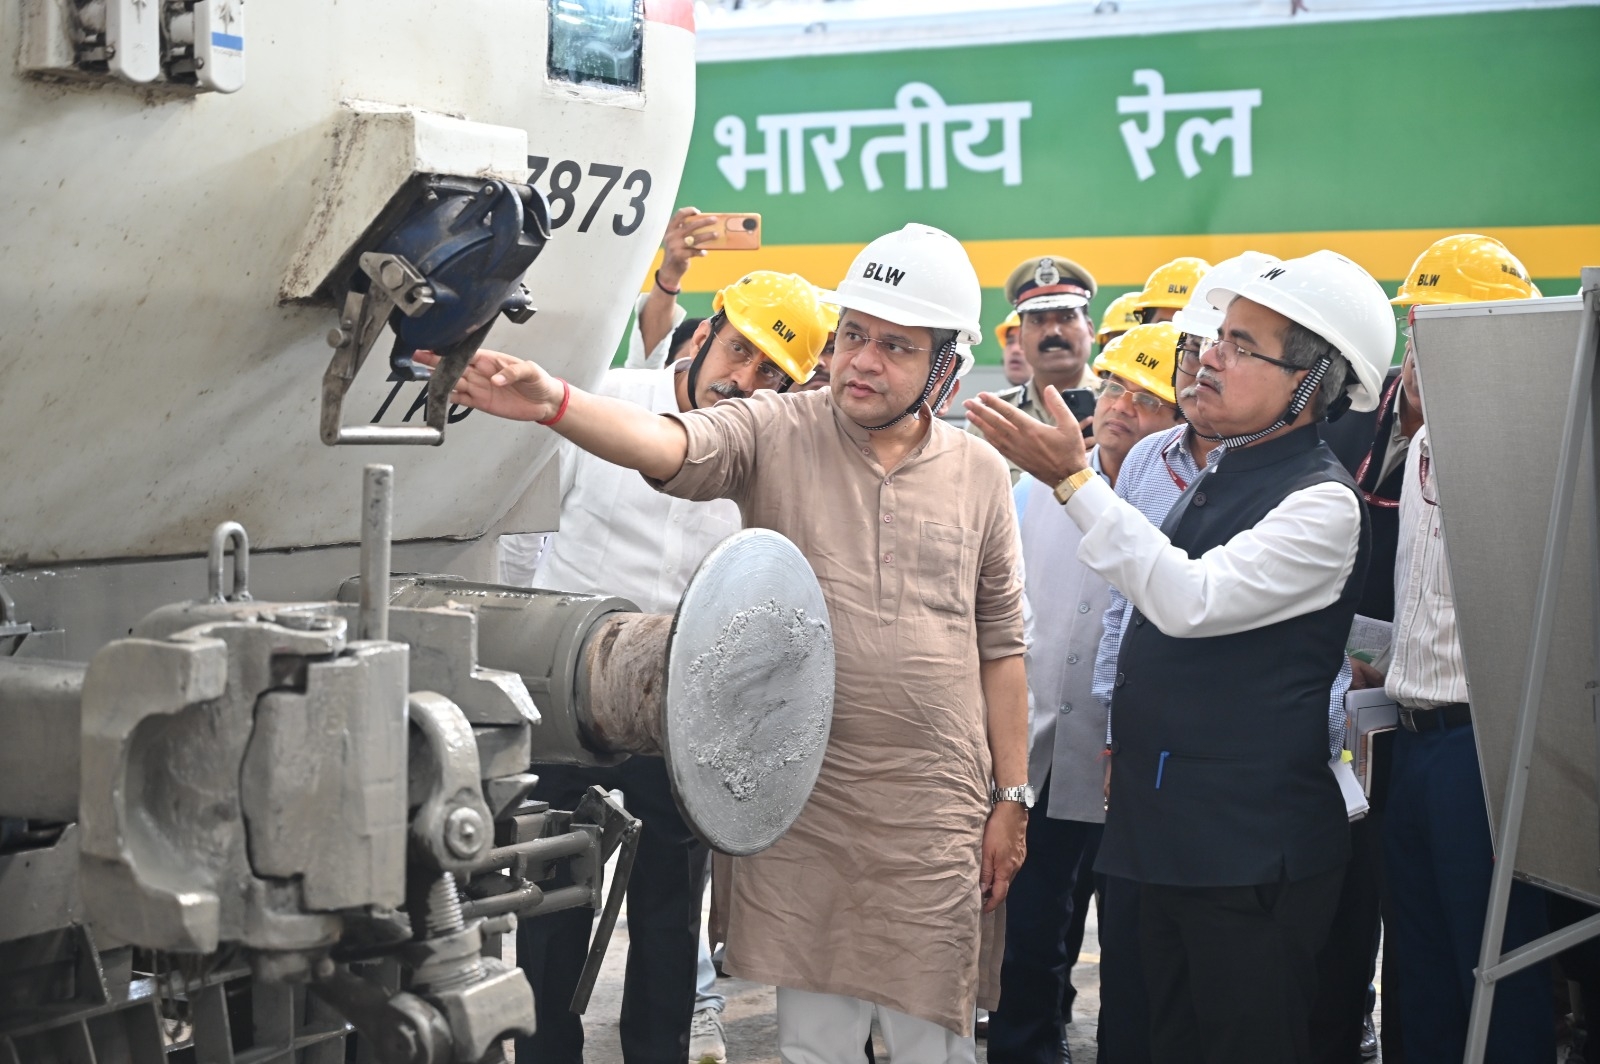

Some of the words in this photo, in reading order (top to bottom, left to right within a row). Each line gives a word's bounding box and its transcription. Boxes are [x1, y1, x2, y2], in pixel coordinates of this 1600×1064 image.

[713, 82, 1031, 194] भारतीय
[1116, 68, 1263, 182] रेल
[863, 262, 905, 286] BLW
[1417, 273, 1441, 287] BLW
[1168, 284, 1189, 294] BLW
[772, 320, 796, 343] BLW
[1135, 352, 1160, 370] BLW
